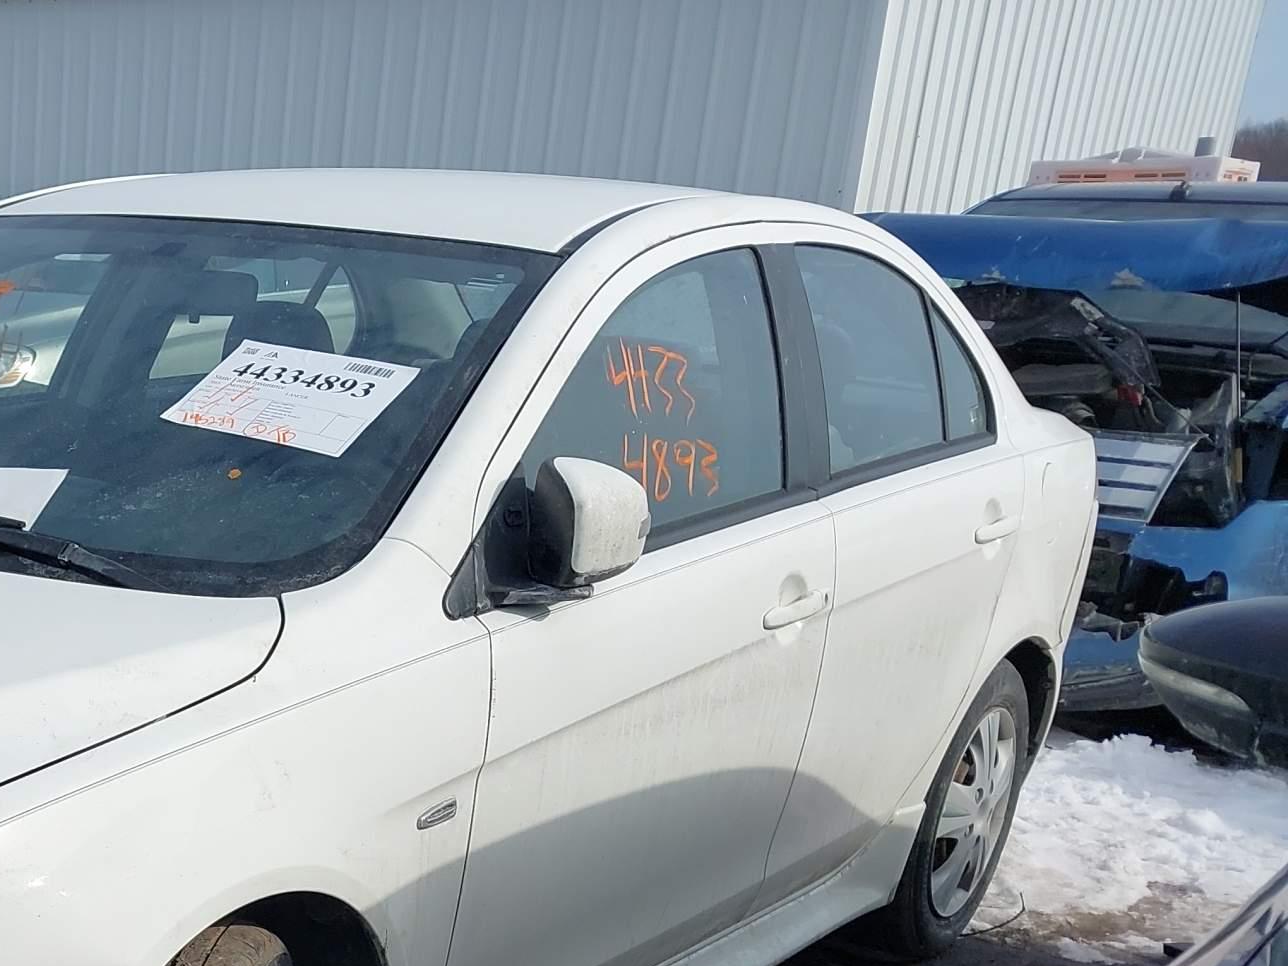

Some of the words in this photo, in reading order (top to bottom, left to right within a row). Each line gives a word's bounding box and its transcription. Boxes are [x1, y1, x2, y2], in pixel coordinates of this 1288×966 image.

[232, 361, 376, 398] 44334893
[252, 379, 287, 390] Insurance
[623, 432, 720, 502] 4893
